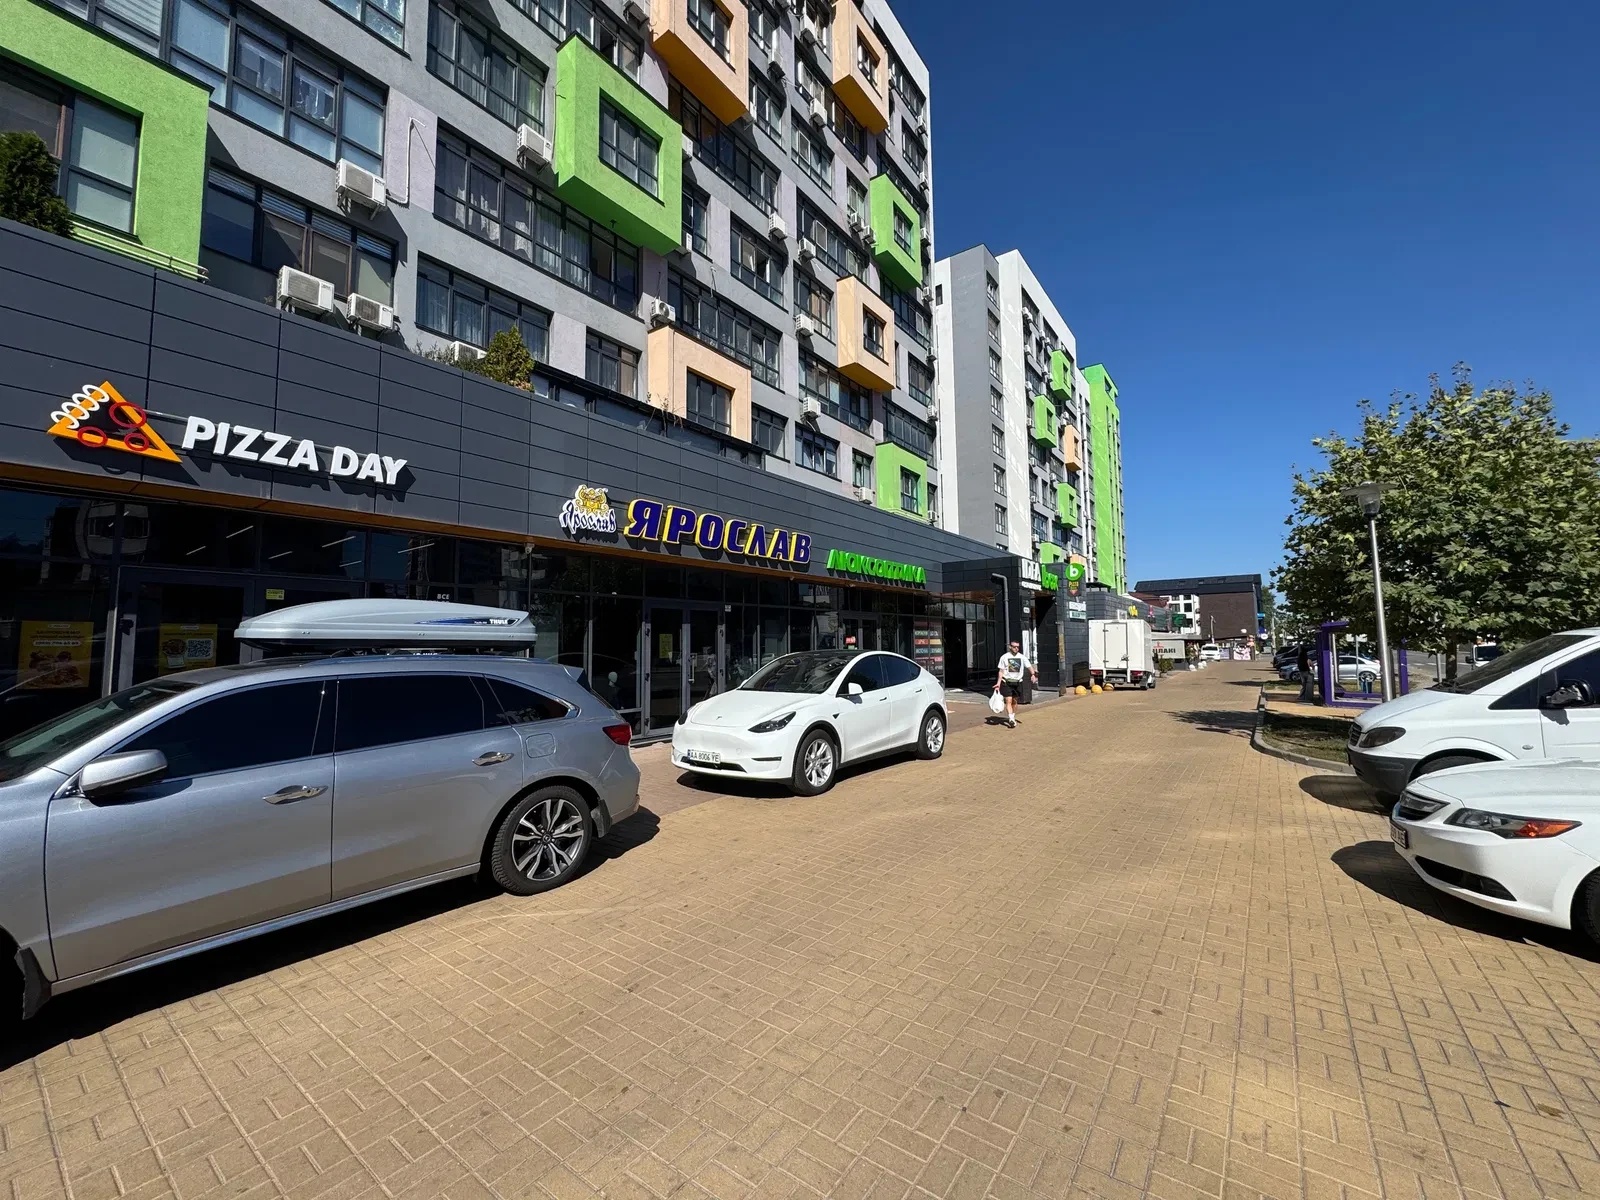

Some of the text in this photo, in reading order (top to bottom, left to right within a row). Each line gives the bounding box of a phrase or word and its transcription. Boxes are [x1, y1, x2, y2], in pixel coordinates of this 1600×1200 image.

[181, 416, 408, 485] PIZZA DAY
[624, 499, 811, 564] ЯРОСЛАВ
[826, 548, 927, 584] ЛЮКСОПТИКА
